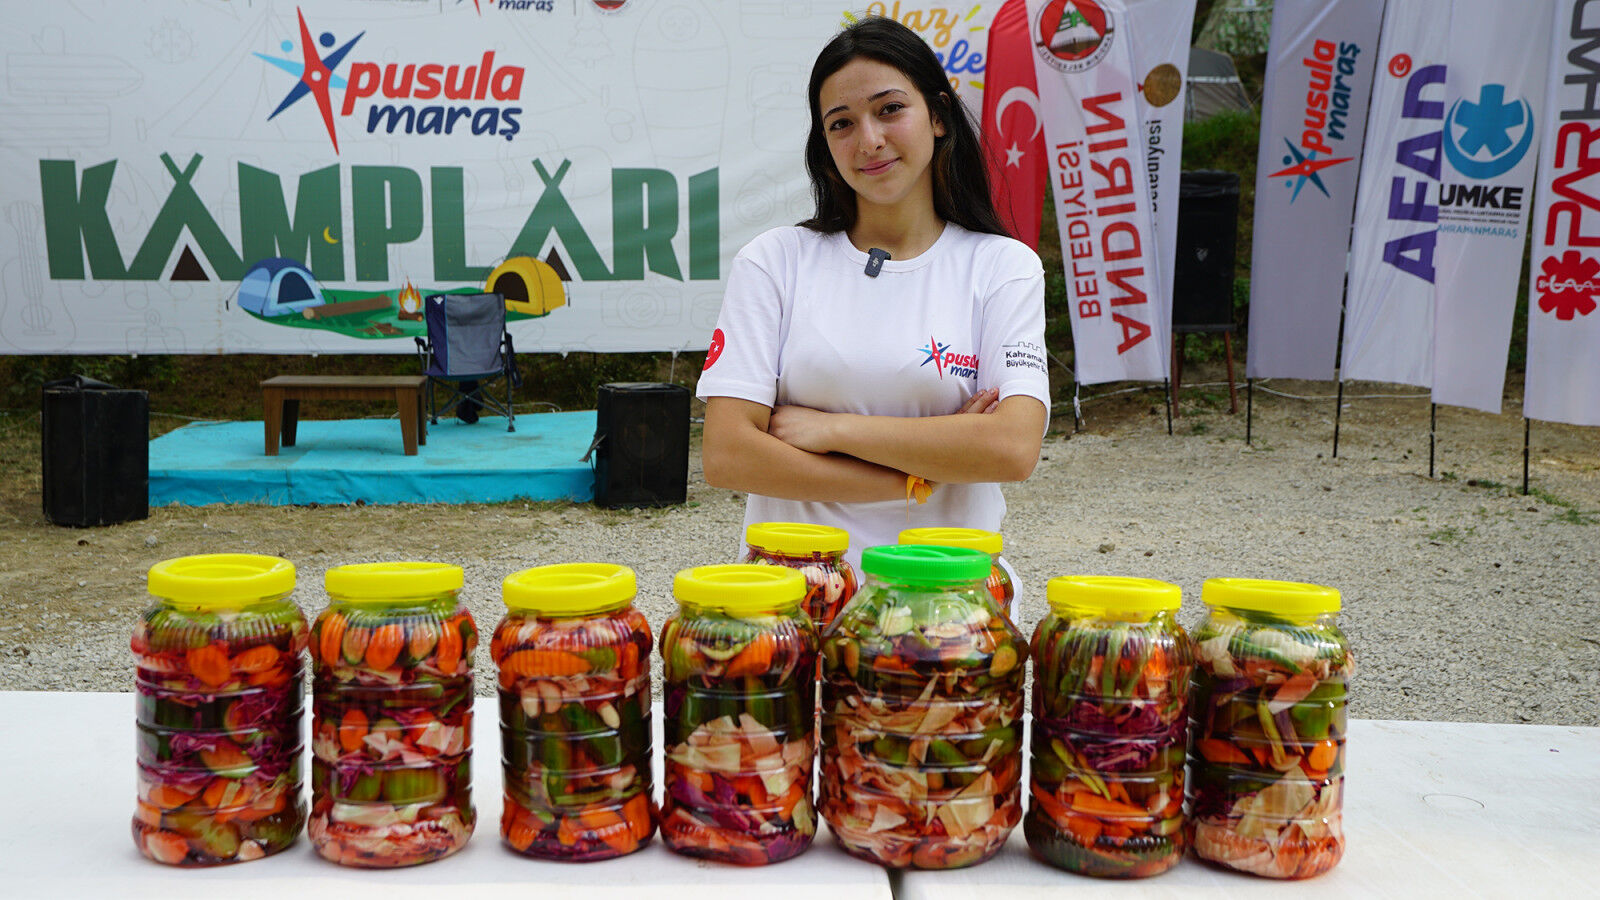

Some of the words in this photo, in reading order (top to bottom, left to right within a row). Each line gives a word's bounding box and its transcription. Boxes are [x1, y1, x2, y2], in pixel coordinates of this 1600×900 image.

[340, 51, 525, 115] pusula
[366, 103, 523, 141] maraş
[1301, 39, 1336, 155] pusula
[1327, 41, 1361, 141] maraş
[1383, 64, 1447, 284] AFAD
[1439, 183, 1523, 210] UMKE
[39, 152, 720, 281] KAMPLARI
[1437, 224, 1518, 238] AHRAMANMARAŞ
